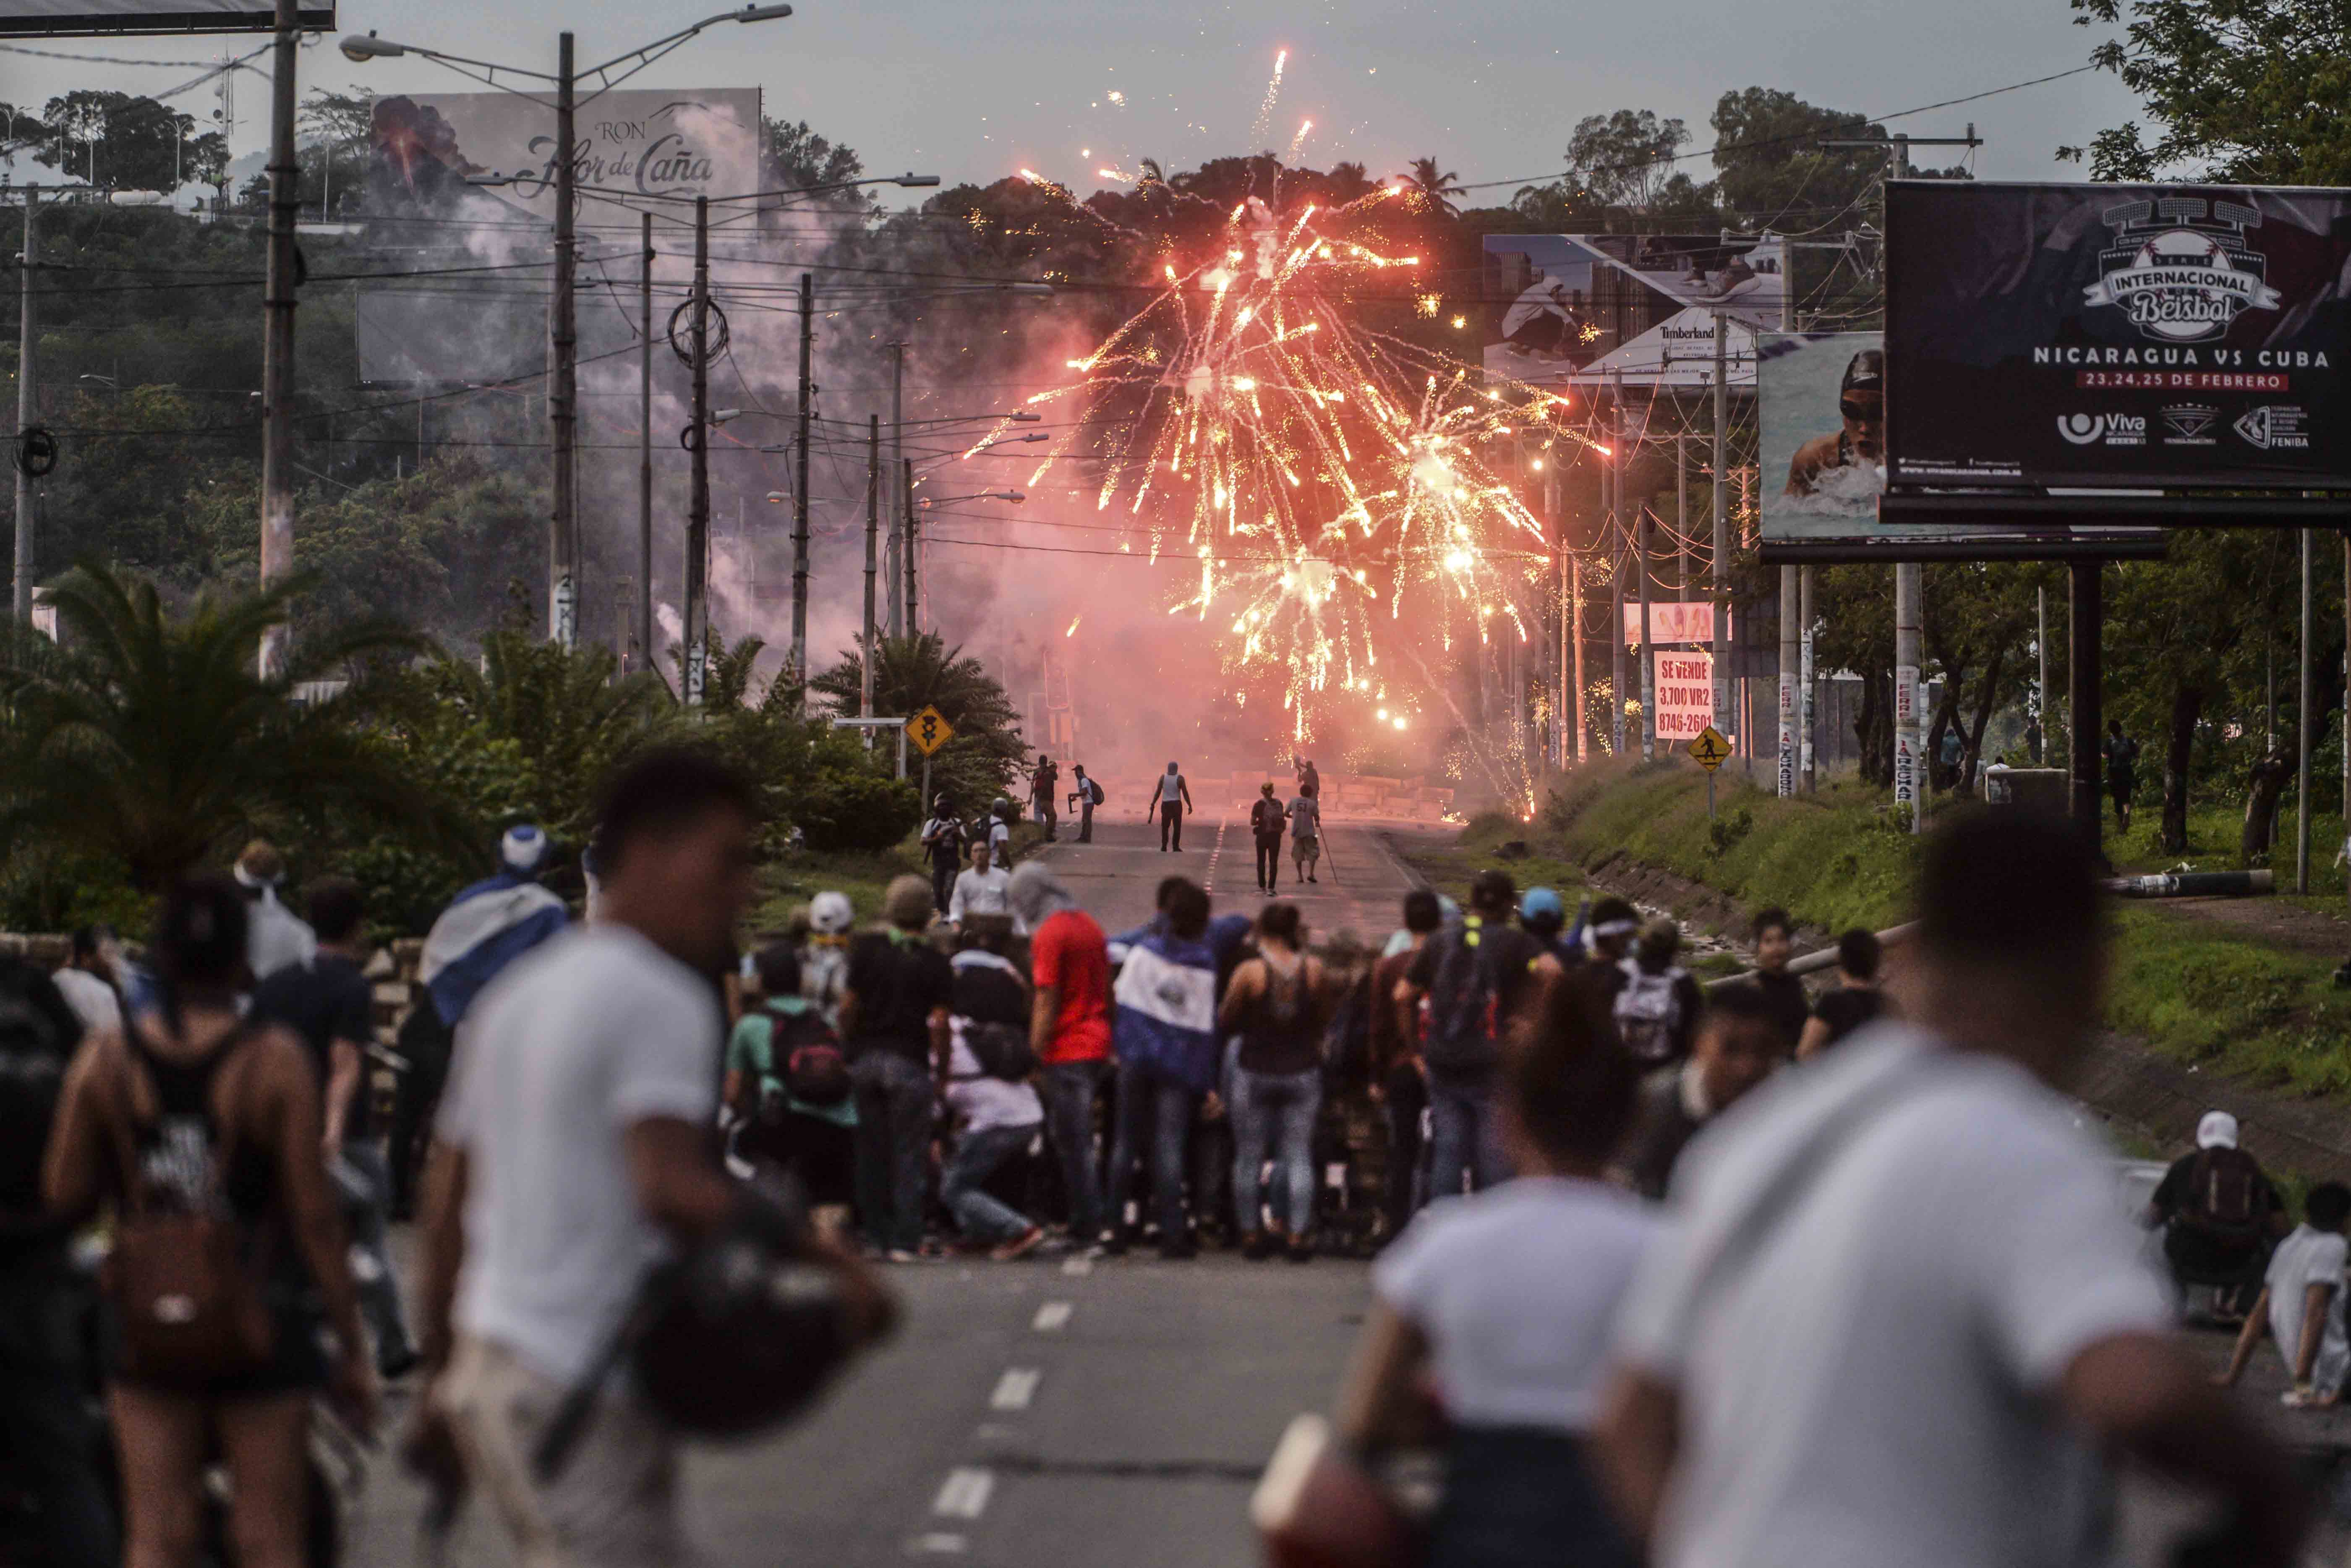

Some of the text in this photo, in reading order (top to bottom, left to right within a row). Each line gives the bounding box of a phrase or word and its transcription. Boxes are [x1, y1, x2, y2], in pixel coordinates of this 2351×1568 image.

[595, 121, 645, 144] RON
[609, 152, 632, 176] de
[635, 133, 713, 195] Caña
[2114, 272, 2249, 293] INTERNACIONAL
[2131, 291, 2235, 323] Beisbol
[1660, 327, 1715, 339] Timberland
[2034, 347, 2330, 368] NICARAGUA VS CUBA
[2172, 374, 2194, 386] DE
[2202, 375, 2280, 389] FEBRERO
[2105, 413, 2146, 430] Viva
[2271, 437, 2309, 447] FENIBA
[1661, 660, 1707, 680] SE VENDE
[1660, 687, 1687, 707] 3,700
[1689, 688, 1709, 706] VR2
[1659, 713, 1711, 732] 8746-2601
